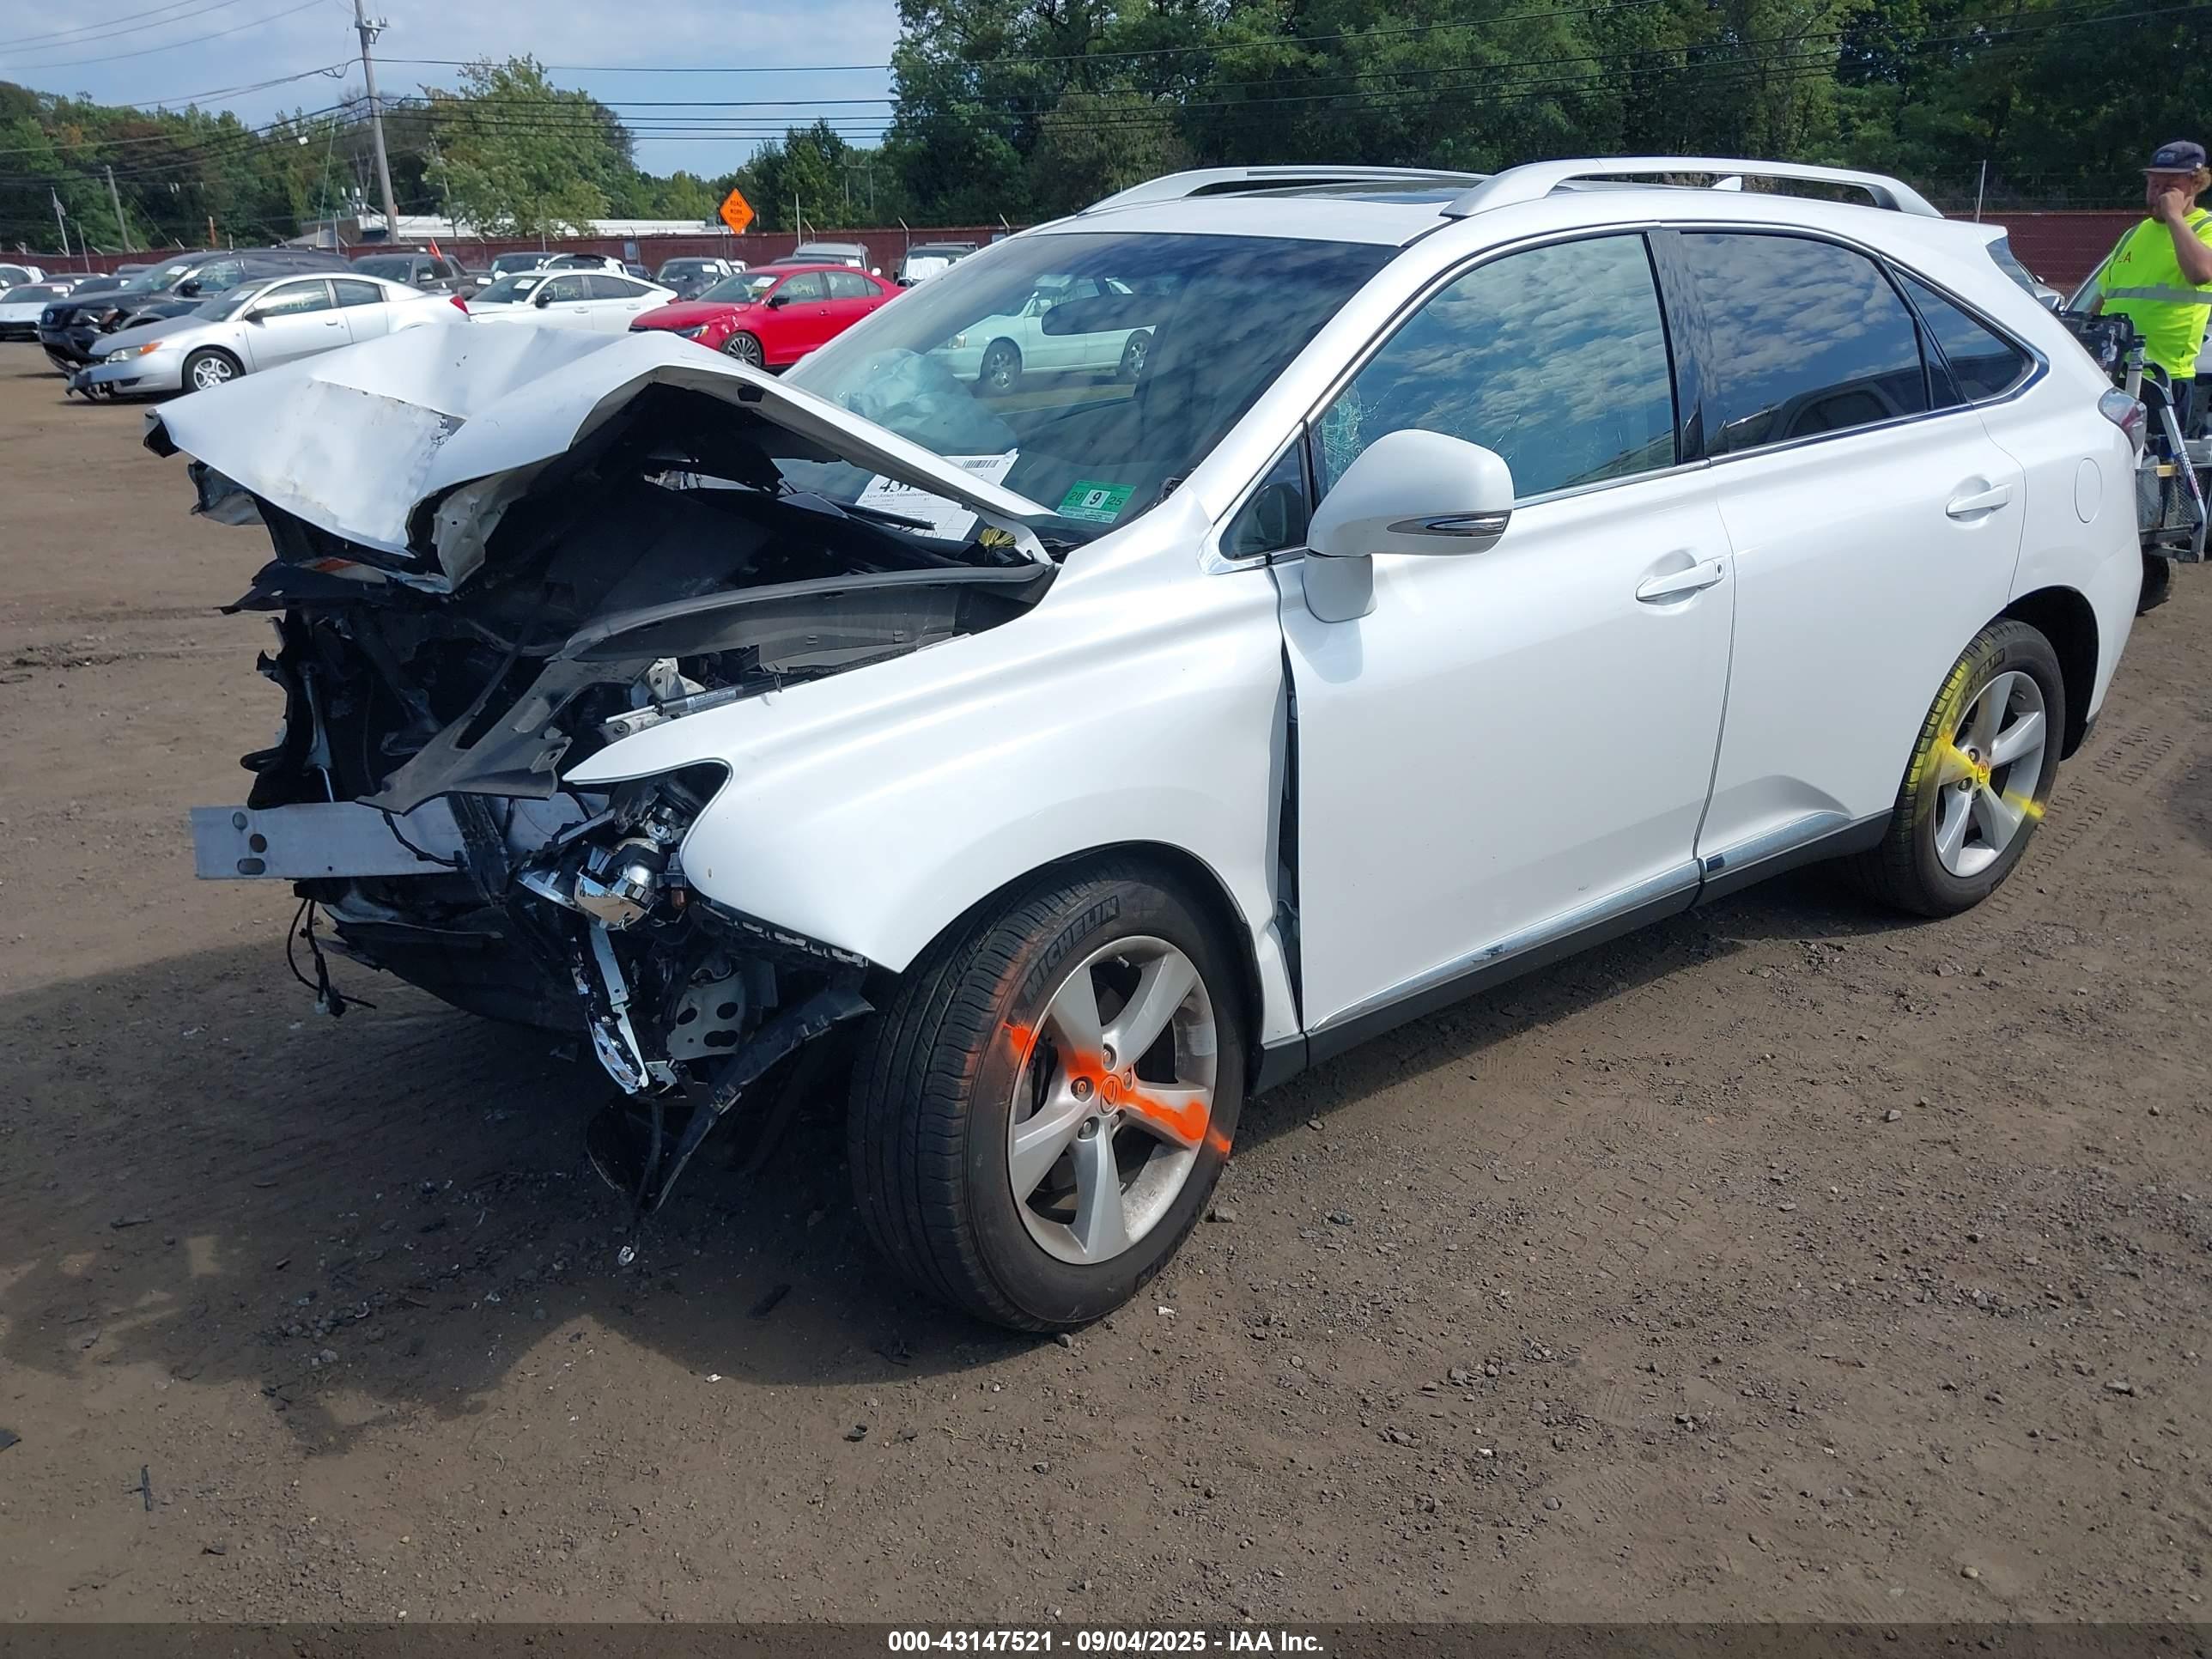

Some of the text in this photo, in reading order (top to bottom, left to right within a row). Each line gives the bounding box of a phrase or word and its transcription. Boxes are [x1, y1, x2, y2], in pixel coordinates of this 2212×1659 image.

[1068, 491, 1124, 506] 20 9 25
[1022, 894, 1120, 1004] MICHELIN
